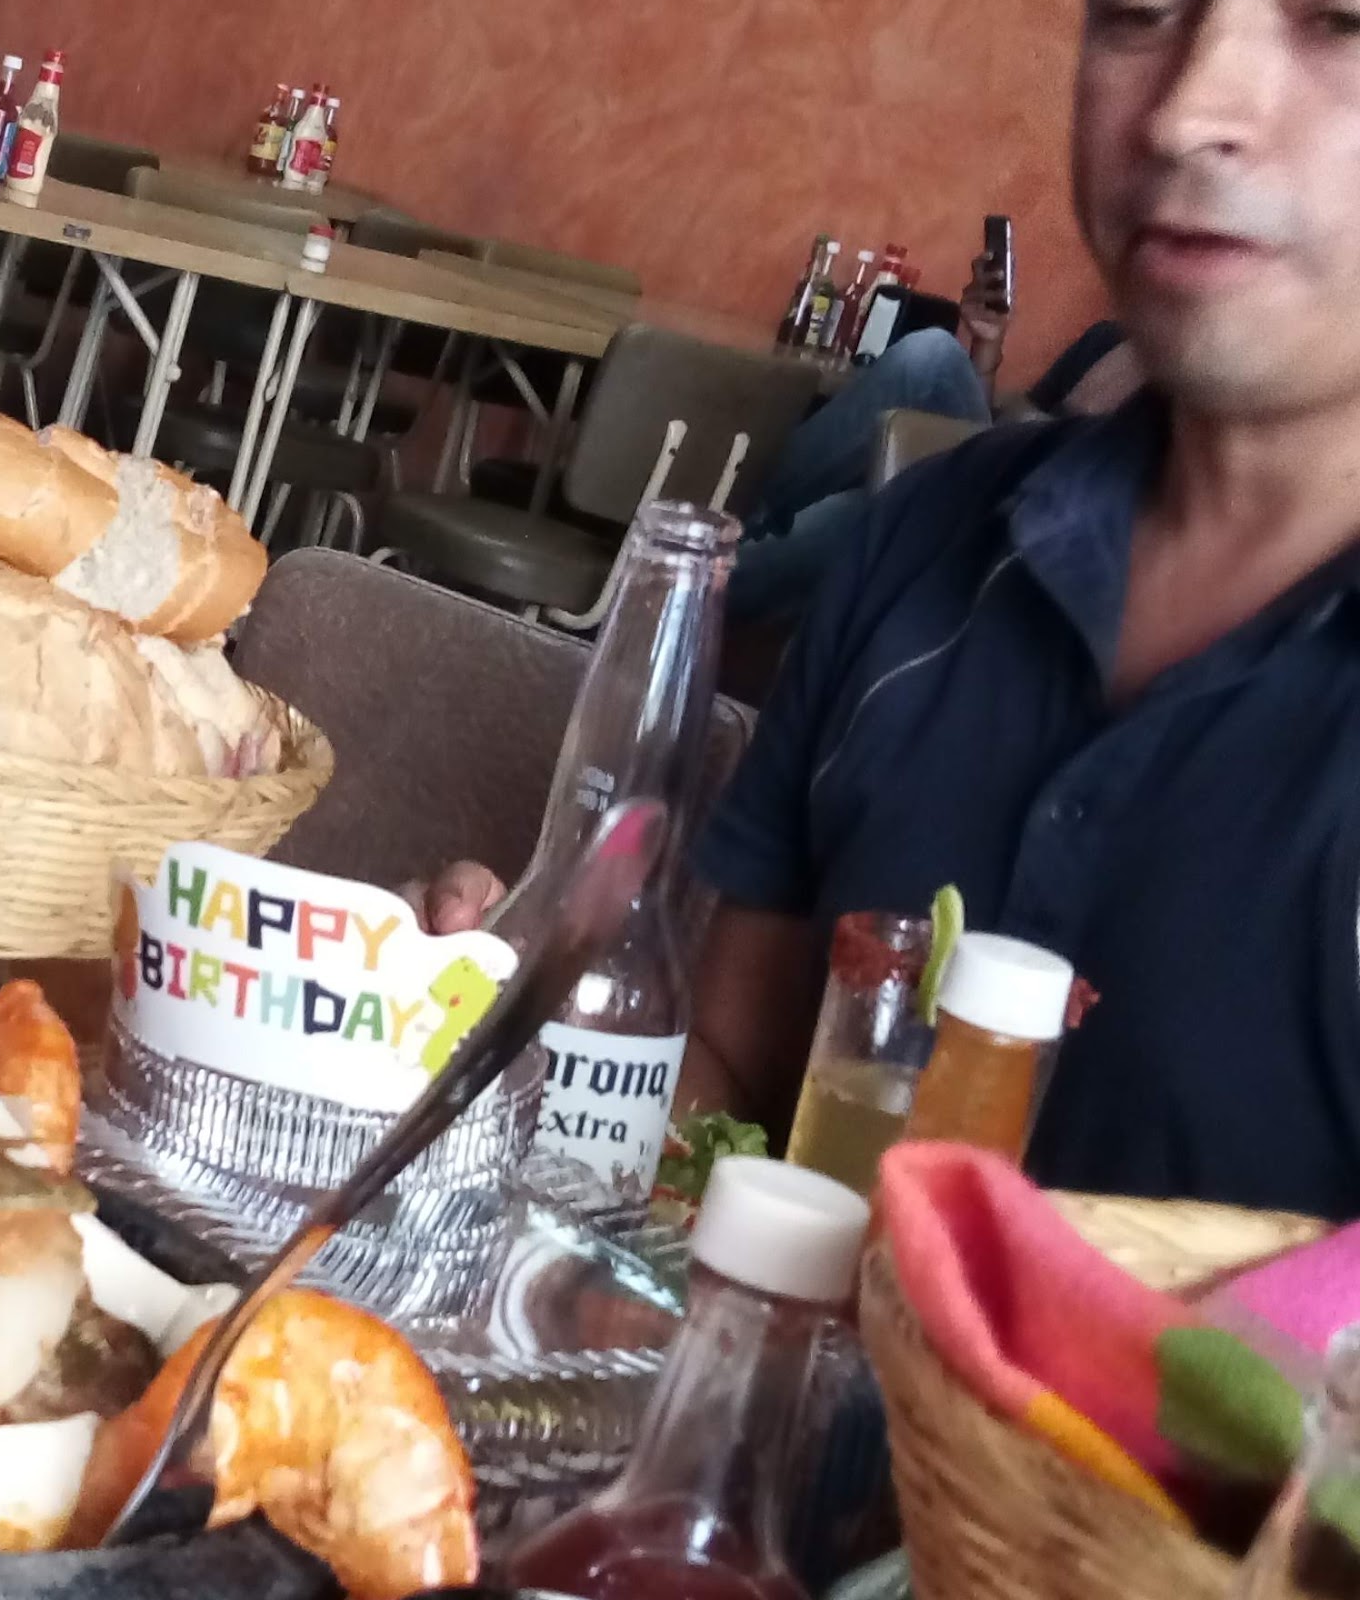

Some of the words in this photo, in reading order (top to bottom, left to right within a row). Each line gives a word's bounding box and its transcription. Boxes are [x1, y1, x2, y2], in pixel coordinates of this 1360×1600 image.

[167, 857, 400, 971] HAPPY
[138, 929, 426, 1049] BIRTHDAY
[545, 1048, 669, 1104] rona
[538, 1109, 628, 1144] xtra
